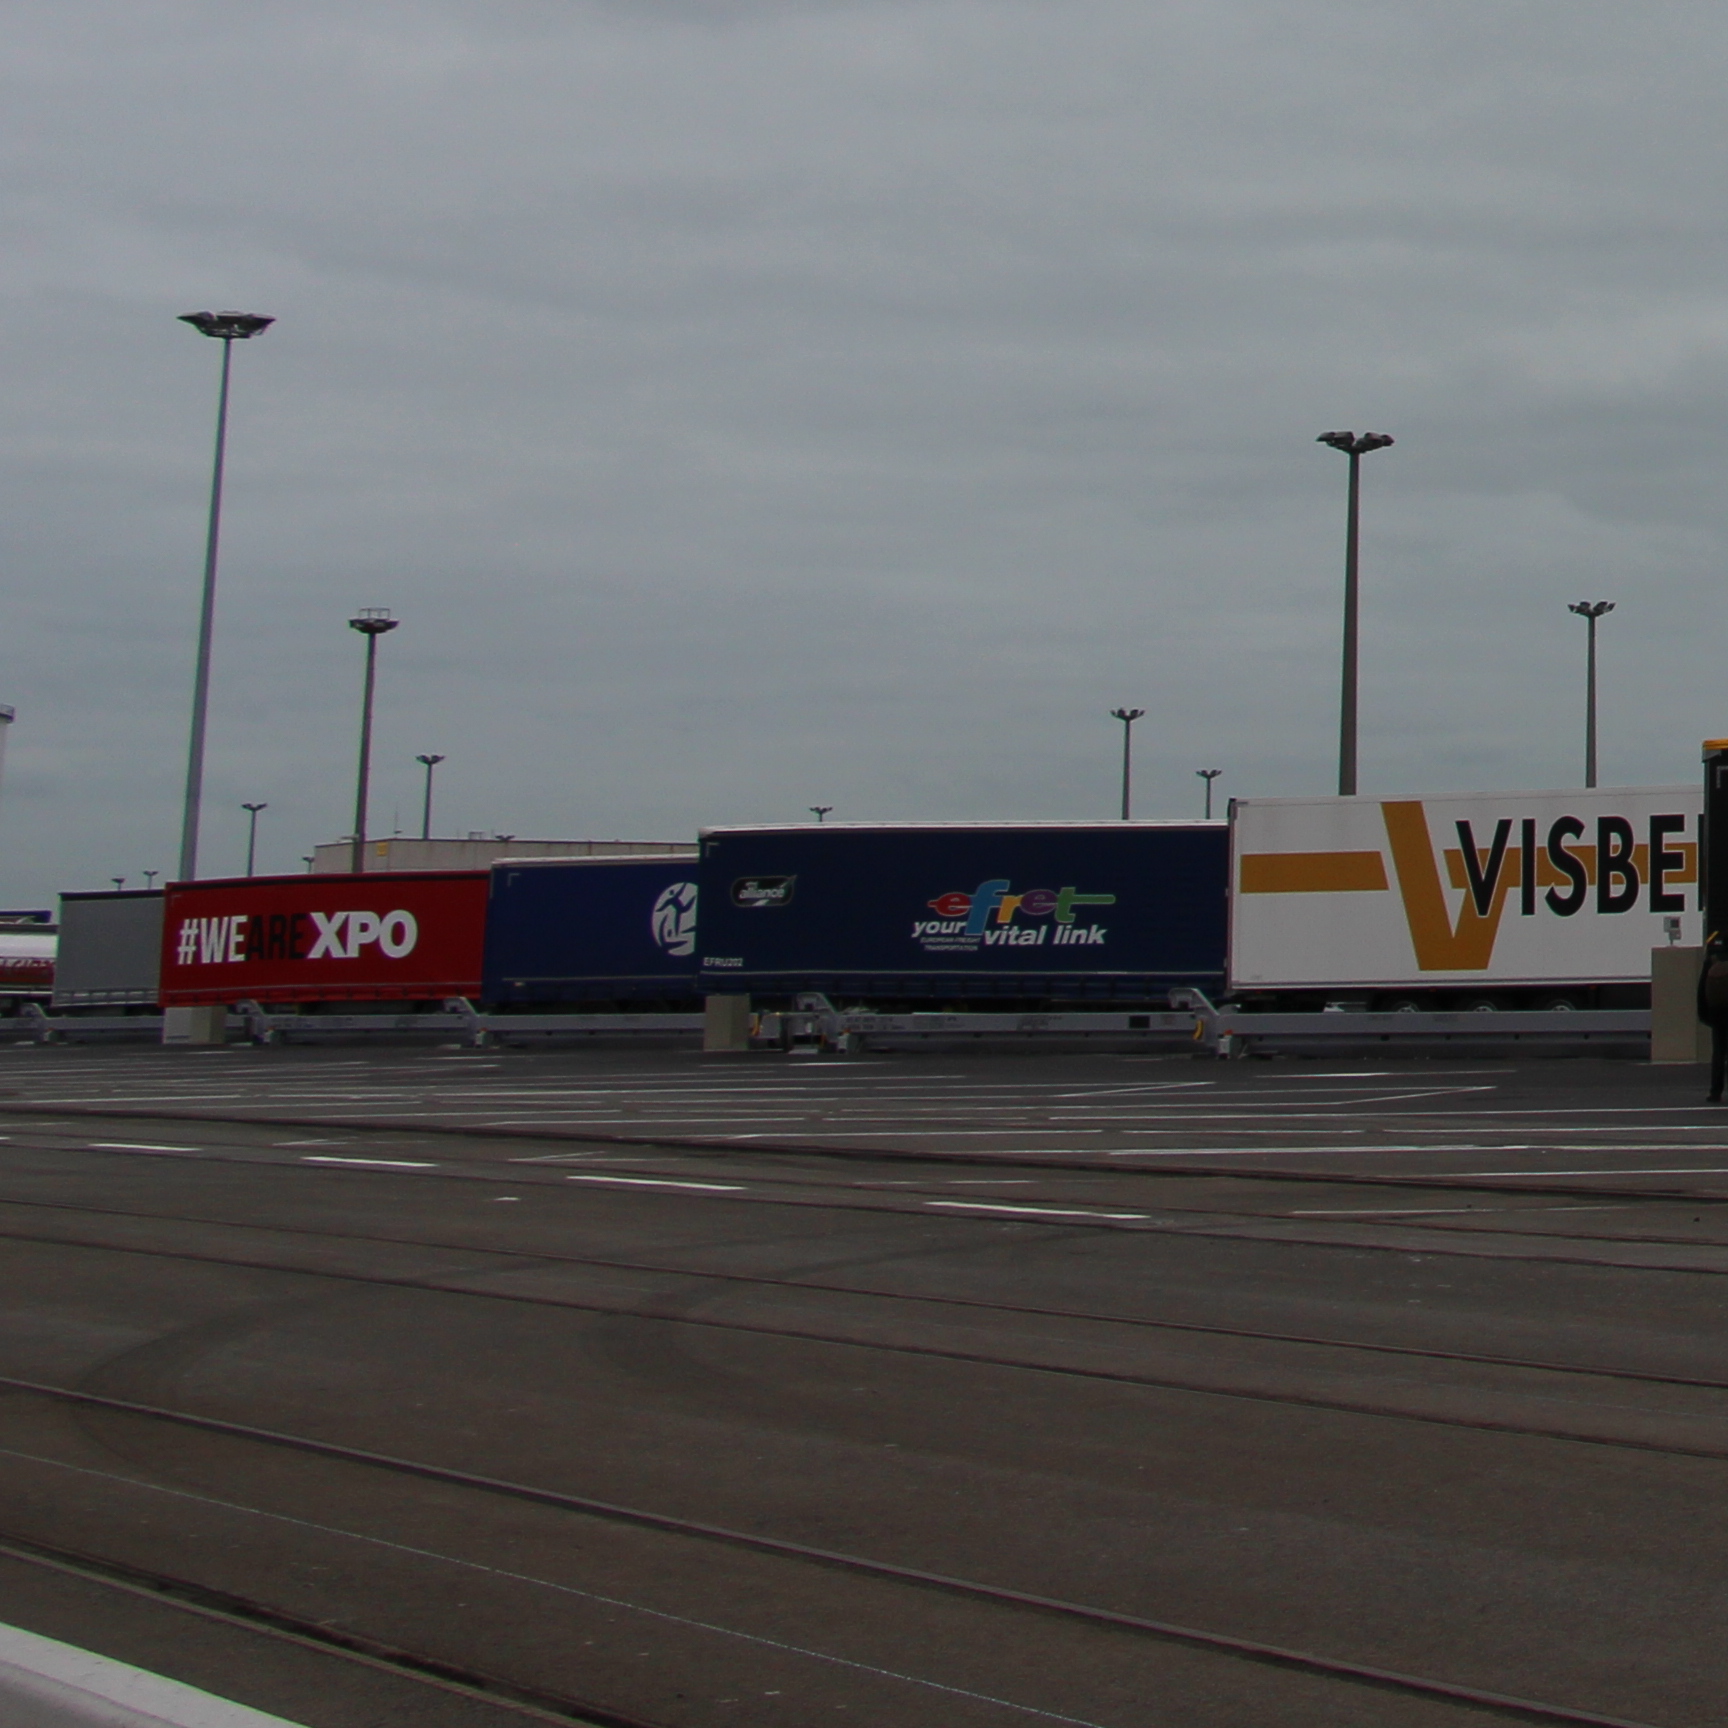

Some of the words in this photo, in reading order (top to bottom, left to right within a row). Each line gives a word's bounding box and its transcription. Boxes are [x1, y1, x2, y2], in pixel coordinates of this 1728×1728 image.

[927, 878, 1116, 936] efret
[911, 921, 967, 938] your
[983, 924, 1048, 946] vital
[1052, 924, 1108, 945] link
